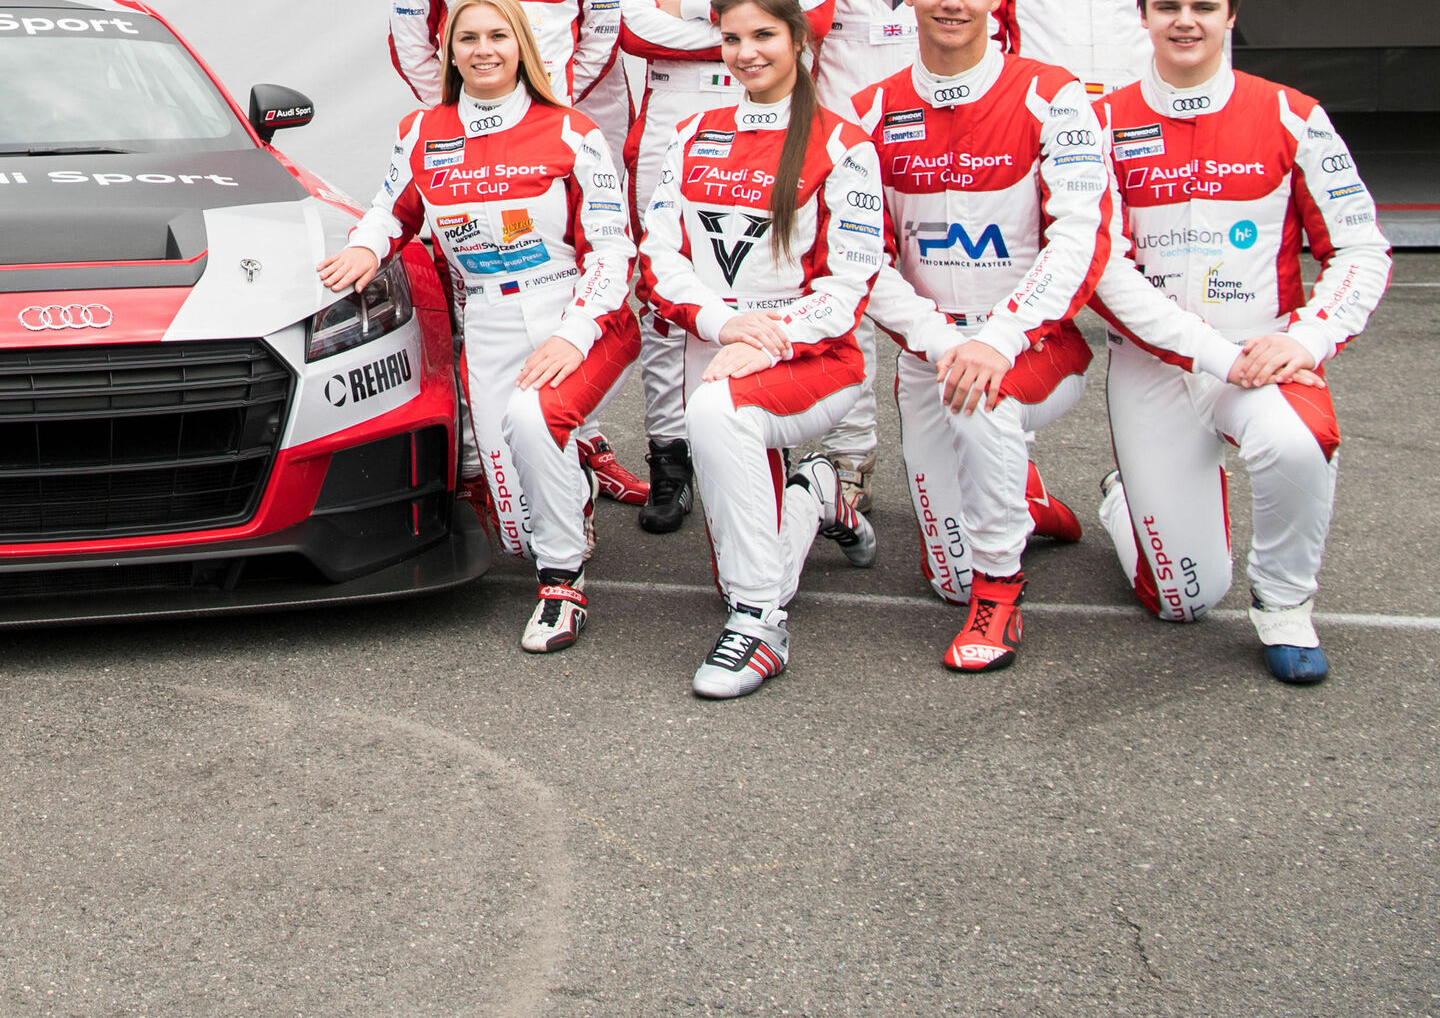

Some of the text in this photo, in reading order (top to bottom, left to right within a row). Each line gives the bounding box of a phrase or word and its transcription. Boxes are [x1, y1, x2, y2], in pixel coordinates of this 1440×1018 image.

[276, 107, 311, 118] Audi Sport
[912, 153, 1012, 169] Audi Sport
[47, 170, 239, 186] Sport
[448, 164, 547, 181] Audi Sport
[707, 168, 748, 182] Audi
[912, 170, 973, 187] TT Cup
[1150, 160, 1264, 181] Audi Sport
[449, 181, 510, 196] TT Cup
[704, 182, 762, 202] TT Cup
[1151, 177, 1222, 198] TT Cup
[445, 219, 478, 241] POCKET
[920, 259, 1012, 268] PERFORMANCE MASTERS
[533, 268, 578, 286] WOHLWEND
[1209, 278, 1242, 288] Home
[757, 298, 795, 308] KESZTHE
[1208, 288, 1255, 302] Displays
[348, 348, 412, 403] REHAU
[490, 449, 513, 514] Sport
[915, 473, 957, 594] Audi Sport
[944, 517, 965, 558] Cup
[1143, 515, 1186, 622] udi Sport
[1180, 557, 1200, 597] Cup
